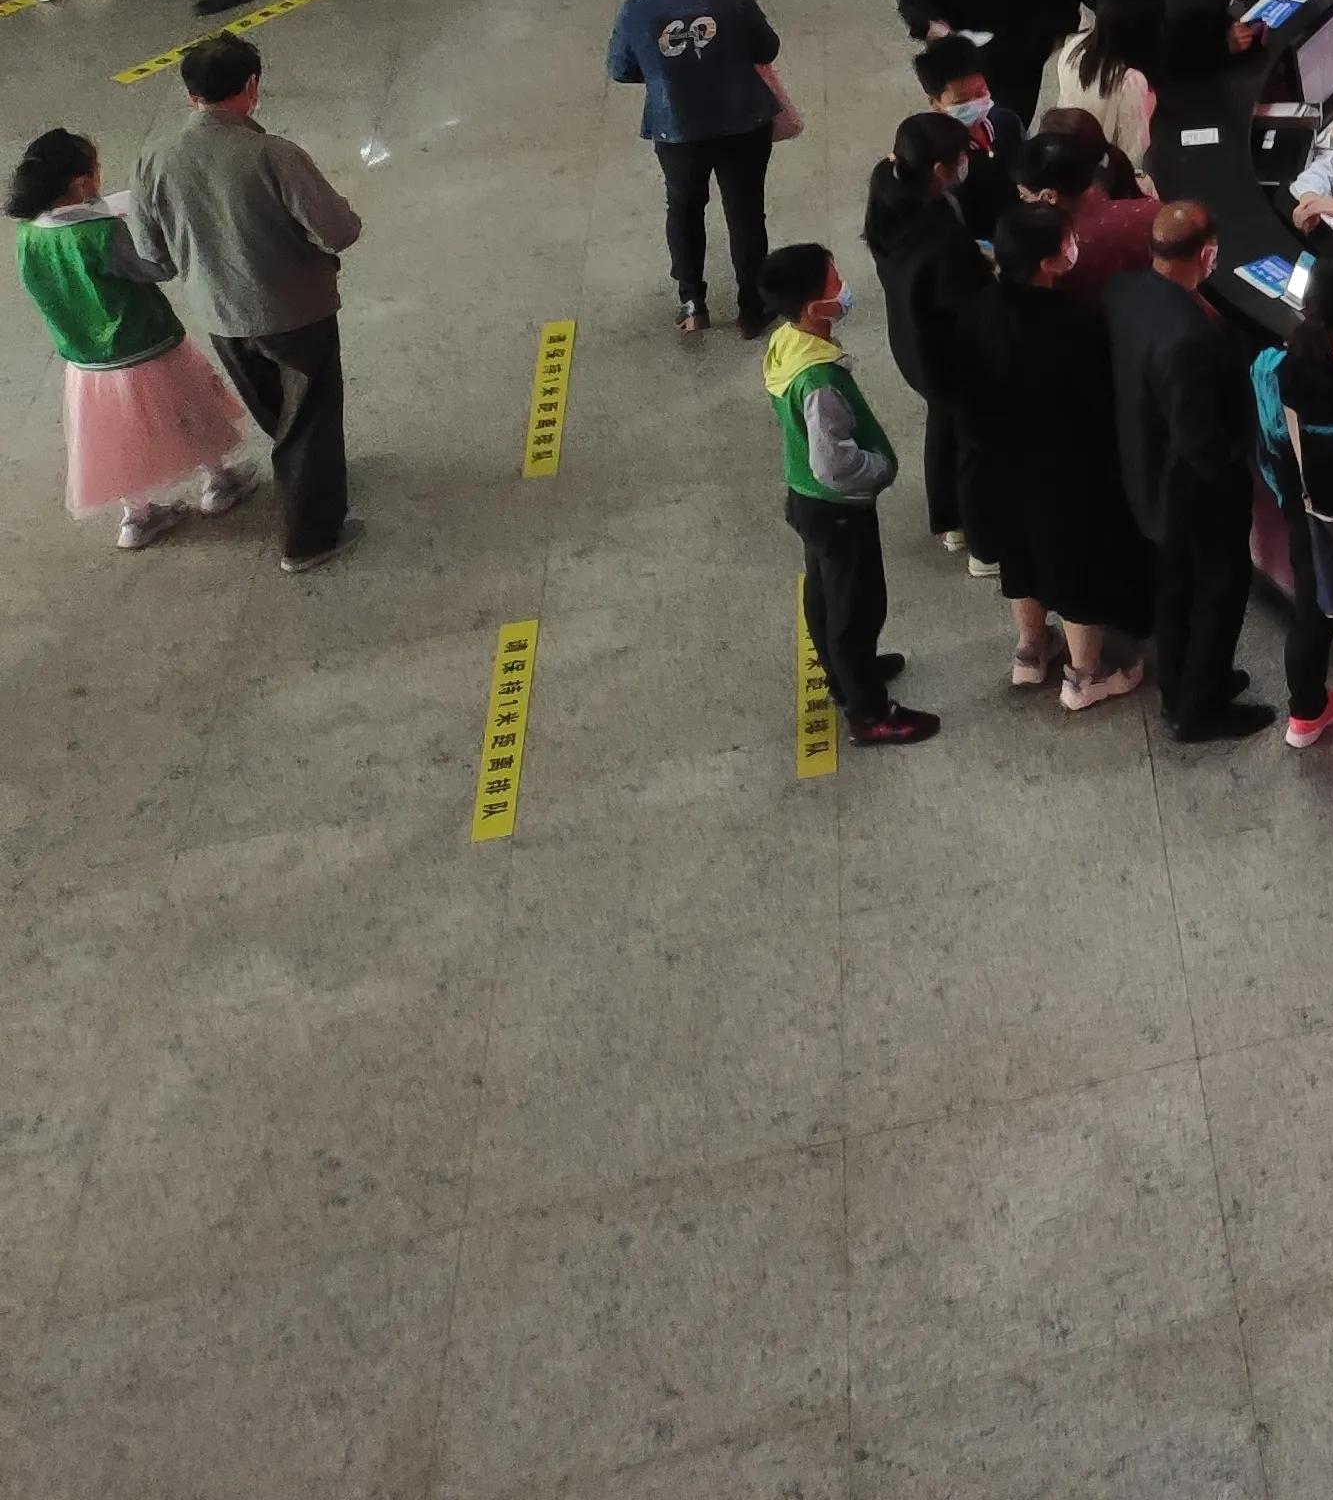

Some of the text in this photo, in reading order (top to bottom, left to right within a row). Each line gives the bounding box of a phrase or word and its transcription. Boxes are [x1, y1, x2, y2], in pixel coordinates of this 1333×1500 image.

[531, 331, 569, 463] 请保持1米距离排队
[481, 637, 530, 821] 请保持1米距离排队
